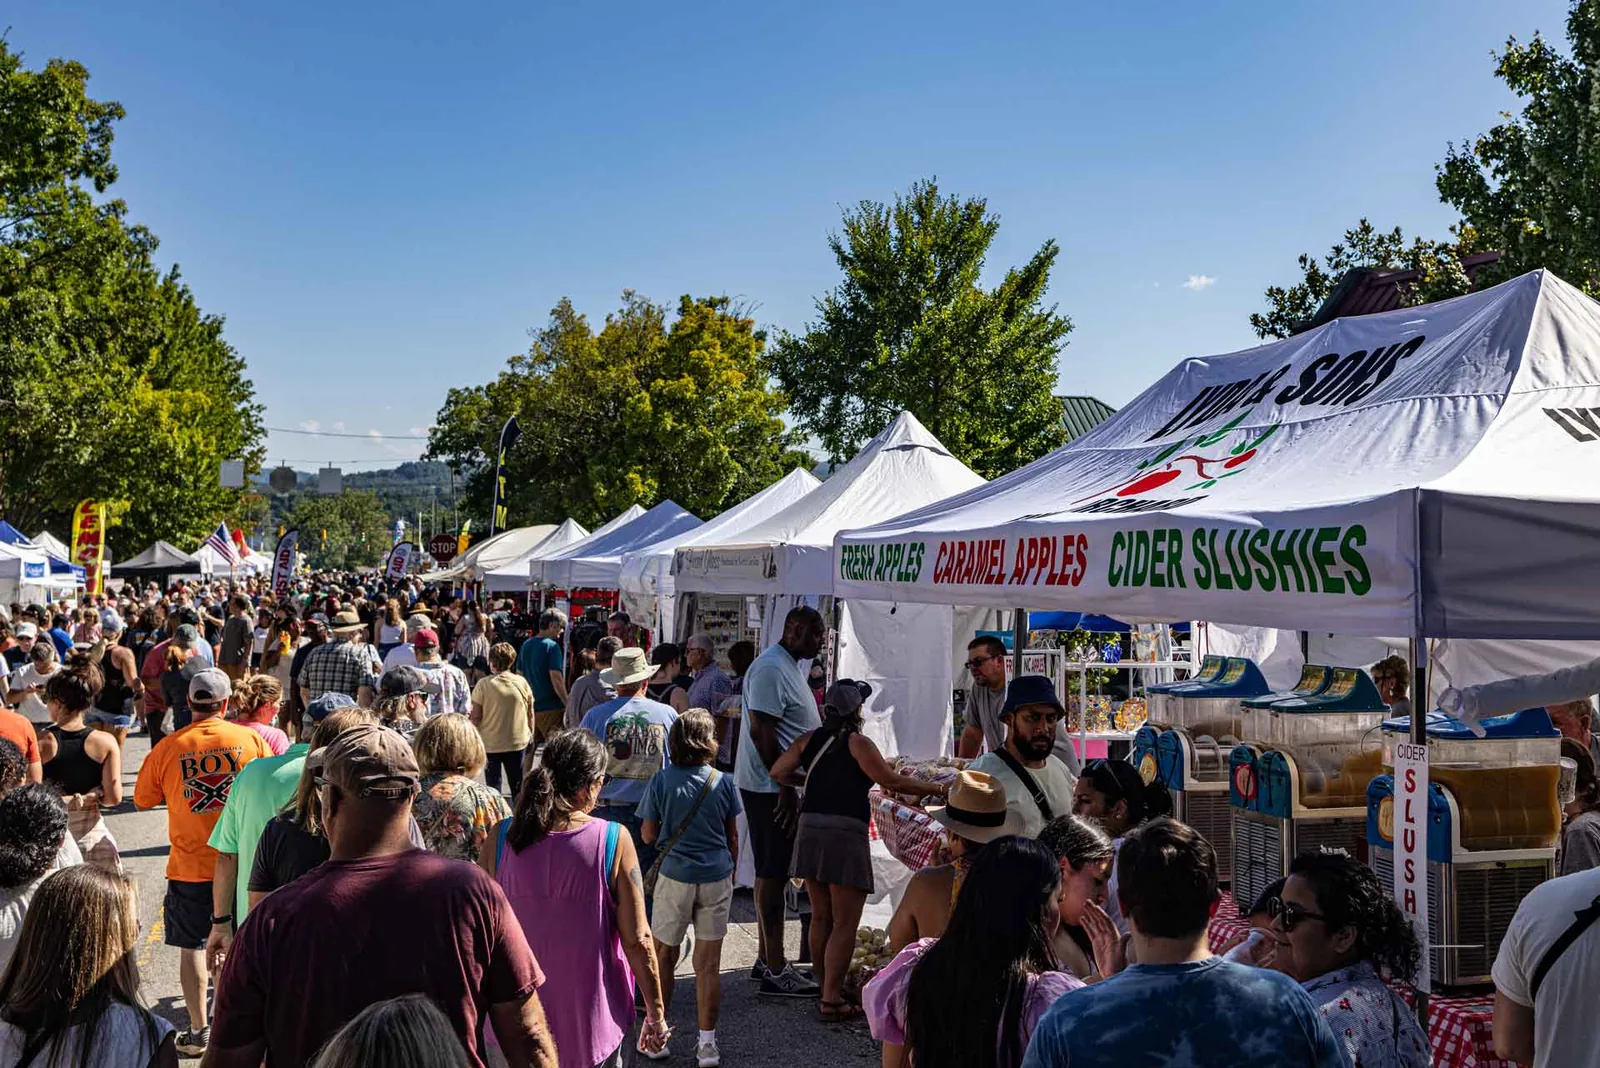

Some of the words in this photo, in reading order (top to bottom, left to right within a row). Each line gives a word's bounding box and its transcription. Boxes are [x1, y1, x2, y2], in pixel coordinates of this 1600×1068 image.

[1275, 335, 1426, 406] SONS
[1541, 406, 1600, 442] LY
[280, 549, 291, 570] AID
[430, 542, 457, 553] STOP
[840, 543, 875, 582] FRESH
[874, 541, 925, 583] APPLES
[933, 539, 1006, 585] CARAMEL
[1008, 533, 1089, 587] APPLES
[1107, 528, 1187, 589] CIDER
[1193, 523, 1372, 596] SLUSHIES
[180, 751, 242, 780] BOY
[1397, 743, 1426, 762] CIDER
[1403, 768, 1416, 915] SLUSH
